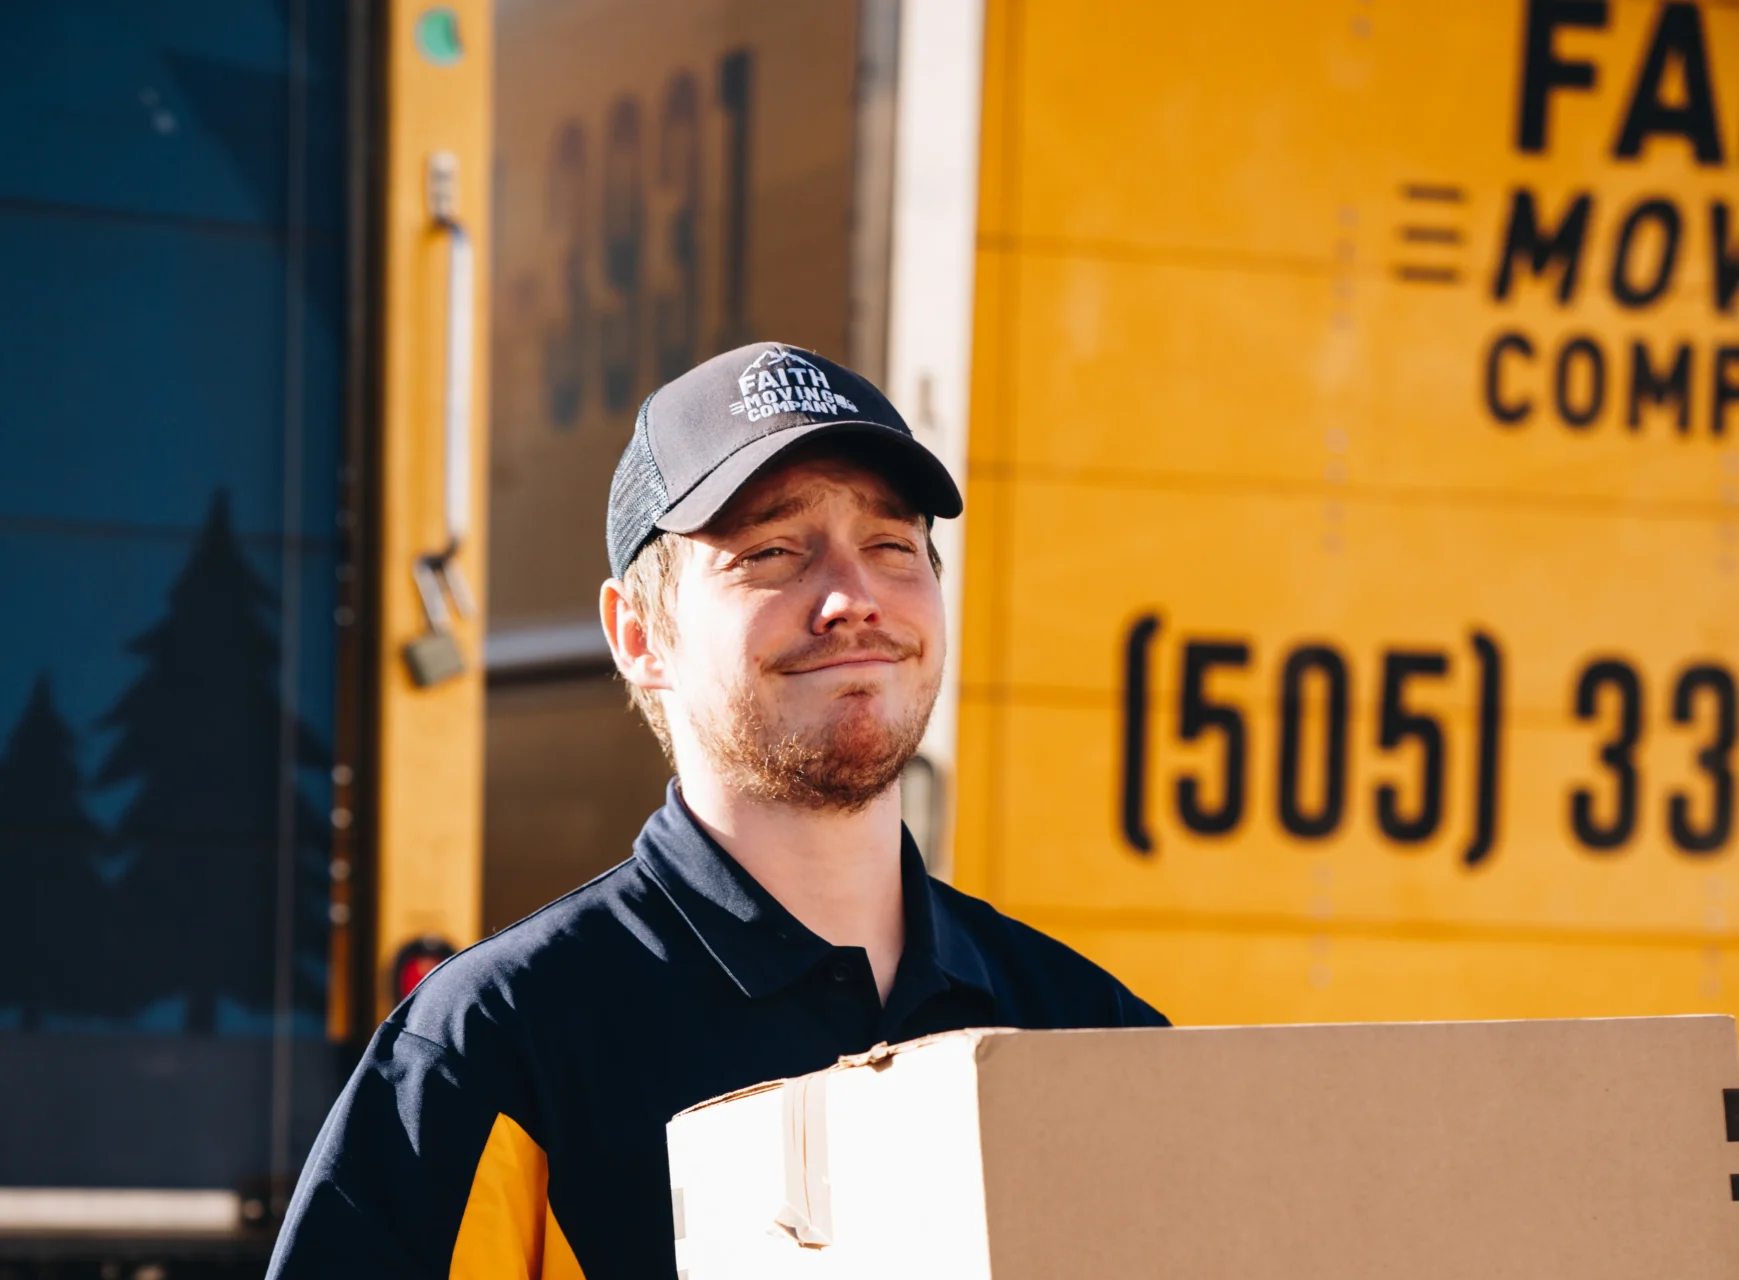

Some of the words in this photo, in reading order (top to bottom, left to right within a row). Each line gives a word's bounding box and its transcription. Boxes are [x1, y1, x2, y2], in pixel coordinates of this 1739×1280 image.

[1516, 0, 1727, 168] FA
[738, 367, 831, 396] FAITH
[743, 385, 837, 411] MOVING
[747, 399, 839, 422] COMPANY
[1118, 608, 1506, 869] (505)
[1570, 658, 1738, 856] 33
